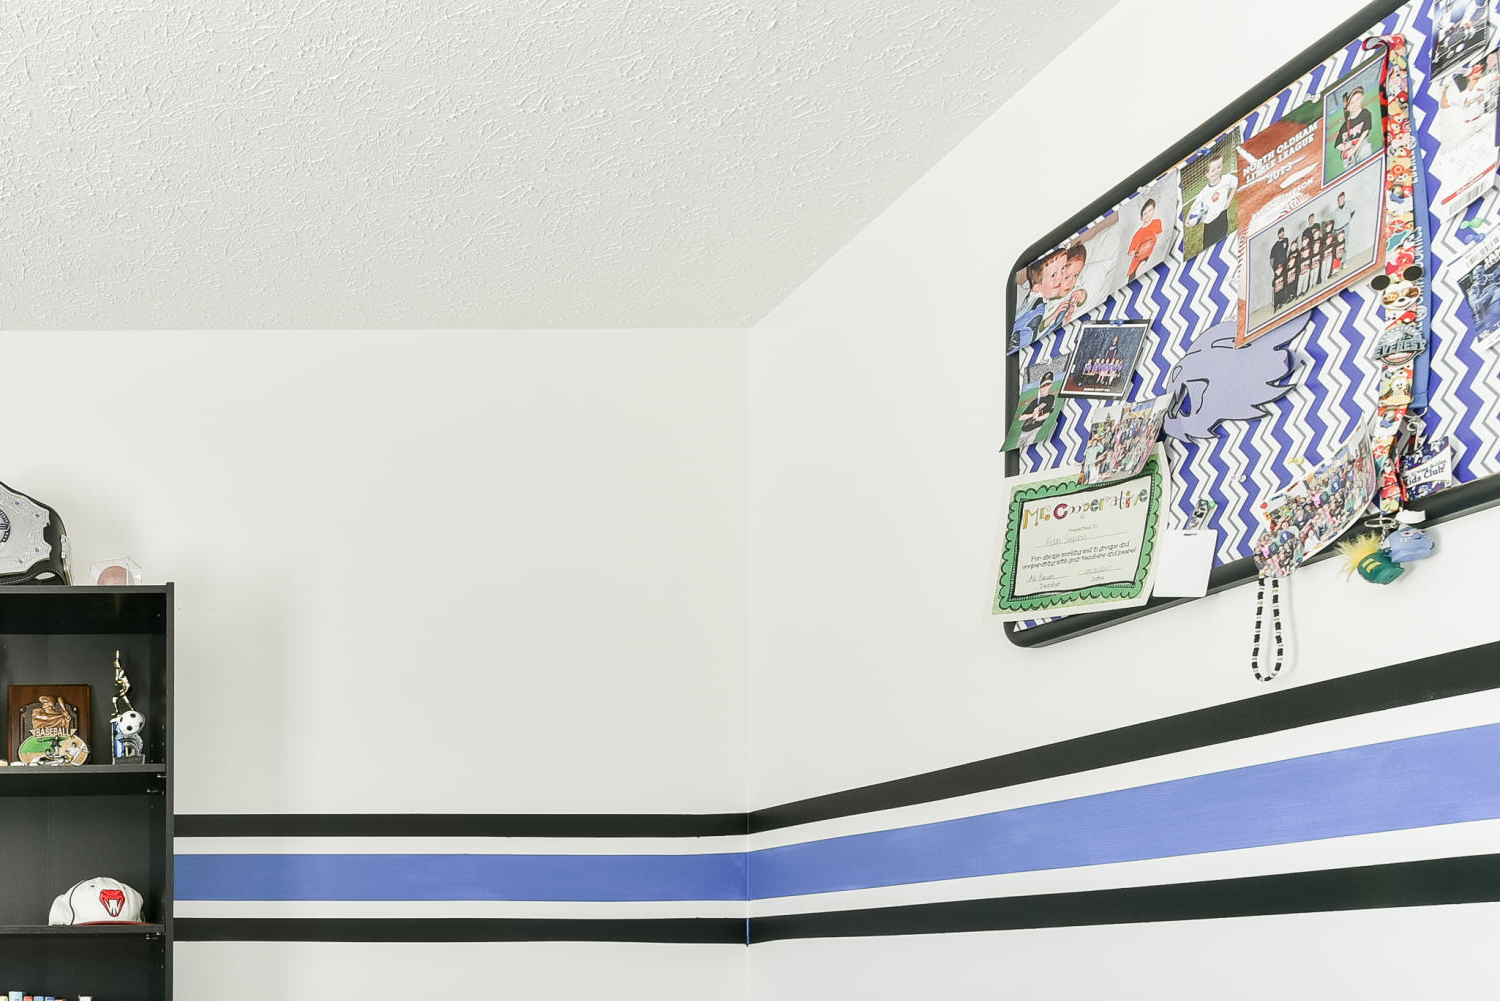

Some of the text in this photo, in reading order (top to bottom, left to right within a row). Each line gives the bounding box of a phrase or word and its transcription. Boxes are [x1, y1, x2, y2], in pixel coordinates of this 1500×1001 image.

[1243, 149, 1276, 176] NORTH
[1276, 121, 1319, 154] OLDHAM
[1279, 133, 1315, 162] LEAGUE
[1022, 488, 1148, 529] Mr. Cooperative
[35, 727, 72, 737] BASEBALL
